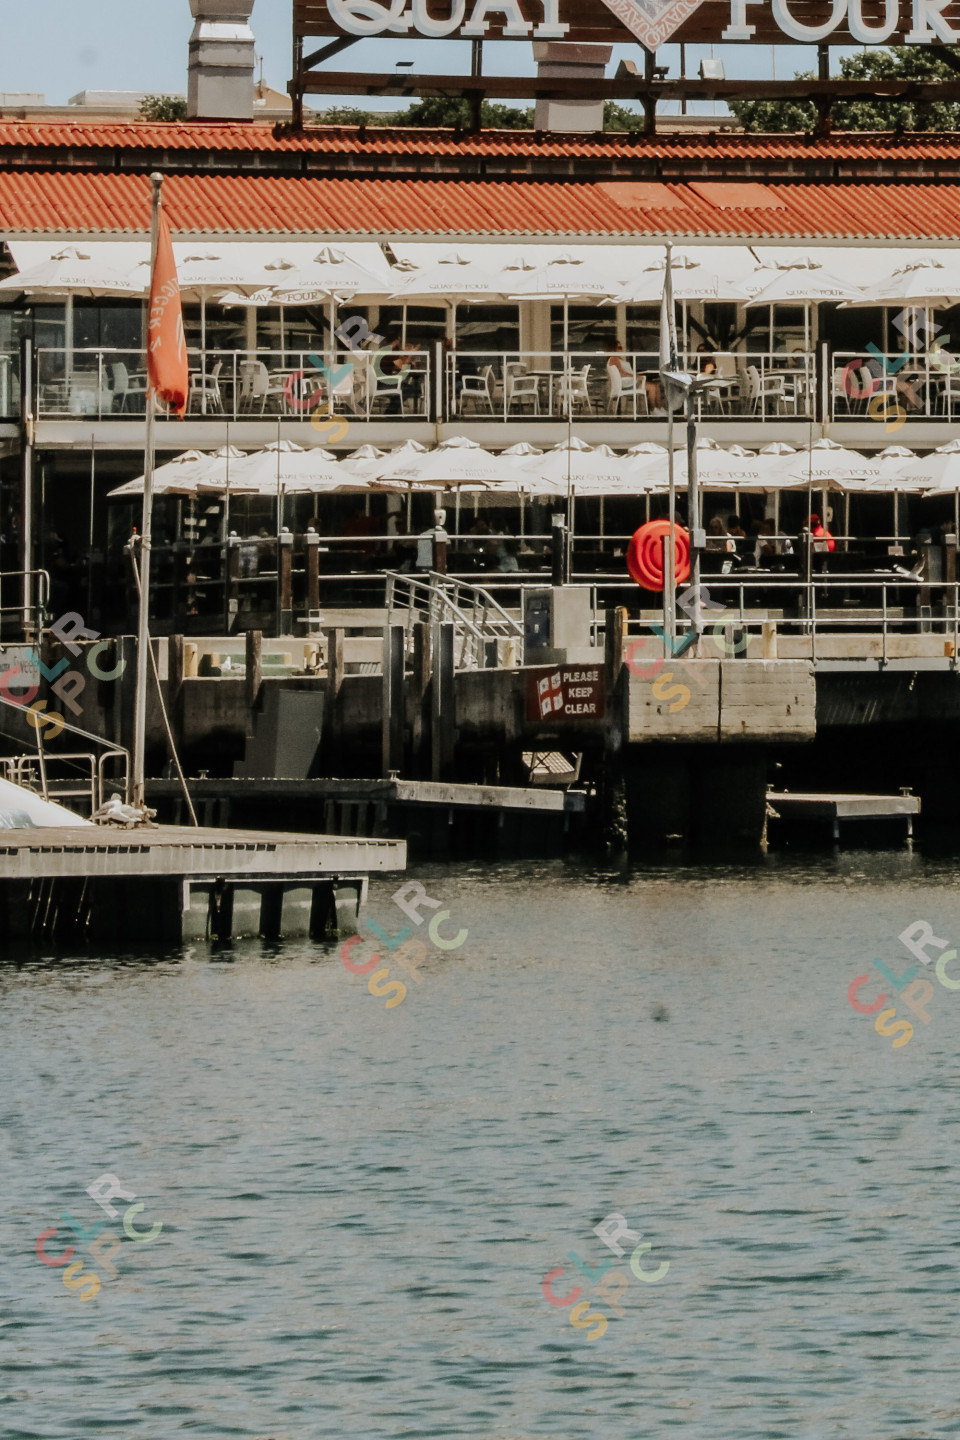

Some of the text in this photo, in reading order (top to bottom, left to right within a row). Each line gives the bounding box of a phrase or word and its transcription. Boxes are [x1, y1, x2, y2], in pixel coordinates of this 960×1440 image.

[287, 292, 319, 302] FOUR
[801, 469, 881, 477] QUAY FOUR
[563, 671, 599, 682] PLEASE
[568, 687, 593, 698] KEEP
[565, 703, 596, 714] CLEAR
